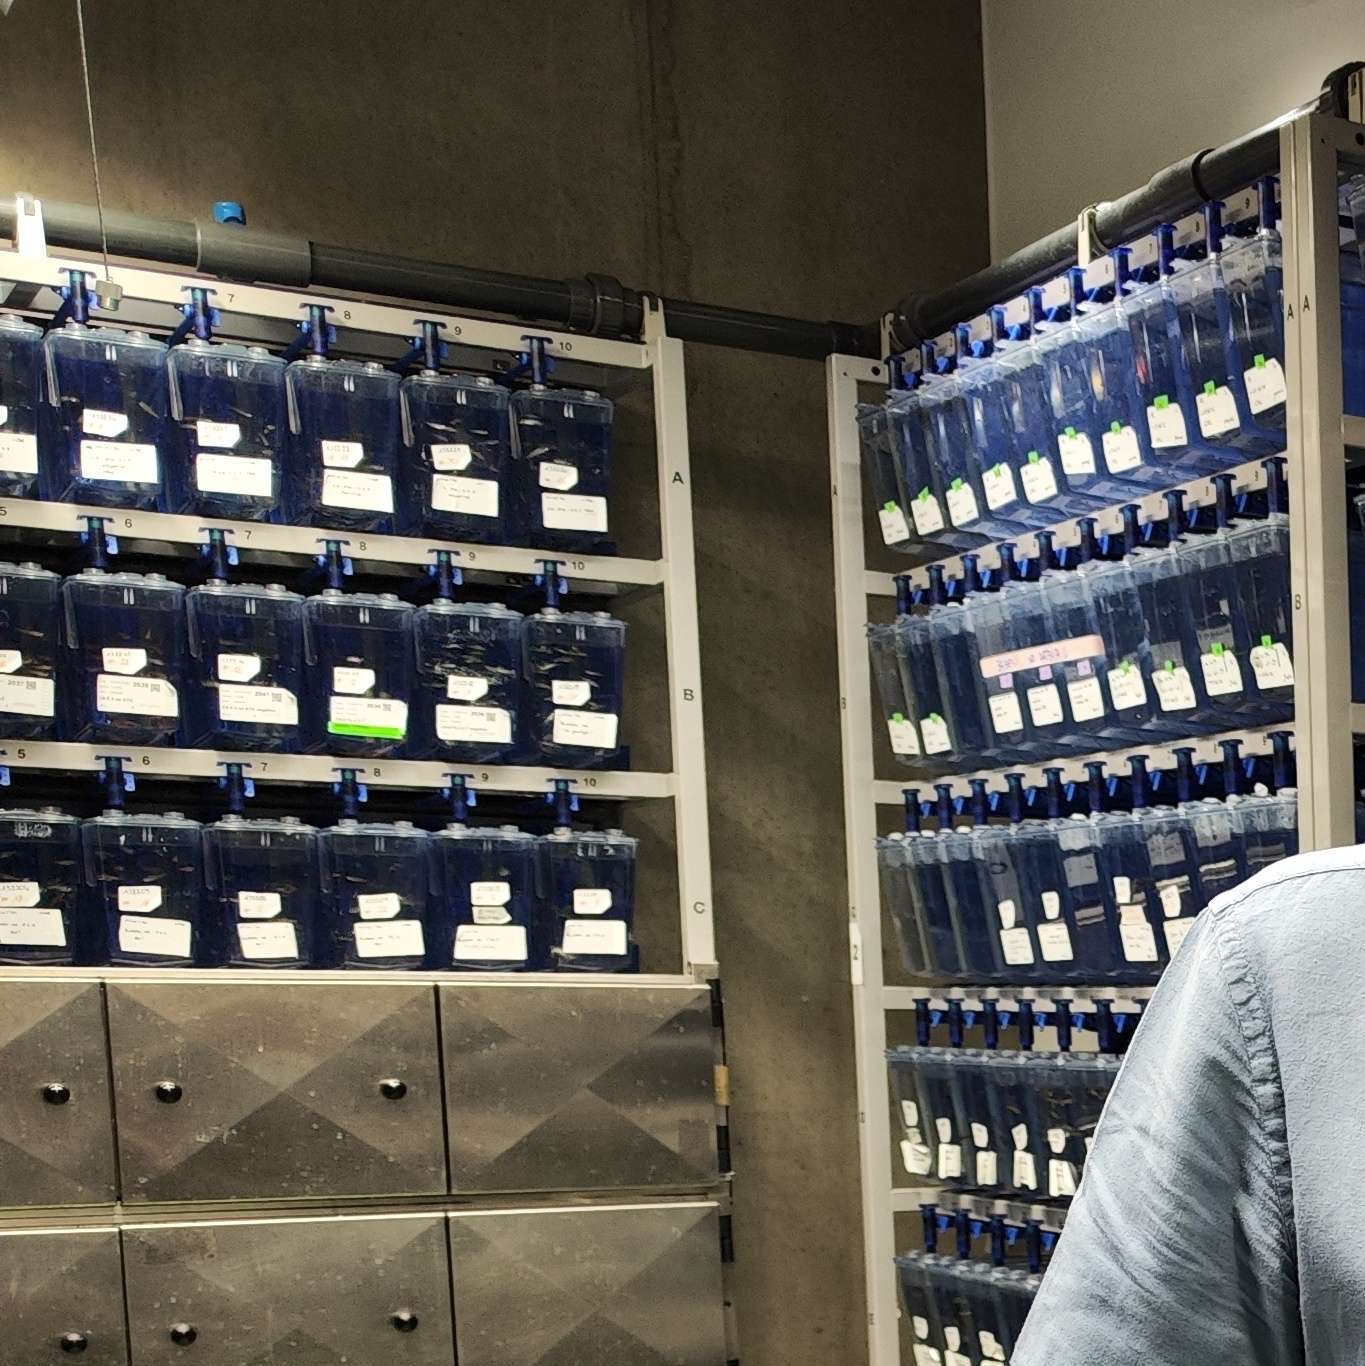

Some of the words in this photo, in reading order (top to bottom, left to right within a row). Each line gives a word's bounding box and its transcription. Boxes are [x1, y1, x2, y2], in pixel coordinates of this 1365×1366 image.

[227, 293, 235, 303] 7
[1303, 295, 1310, 312] A
[344, 310, 352, 320] 8
[1287, 304, 1294, 320] A
[454, 325, 462, 336] 9
[558, 341, 573, 352] 10
[672, 472, 684, 484] A
[124, 518, 133, 528] 6
[244, 530, 252, 540] 7
[359, 541, 367, 551] 8
[468, 551, 476, 561] 9
[571, 561, 585, 571] 10
[683, 688, 694, 701] B
[17, 749, 26, 760] 5
[142, 755, 151, 766] 6
[260, 761, 268, 772] 7
[373, 768, 381, 778] 8
[481, 772, 489, 782] 9
[583, 777, 597, 787] 10
[693, 902, 705, 914] C
